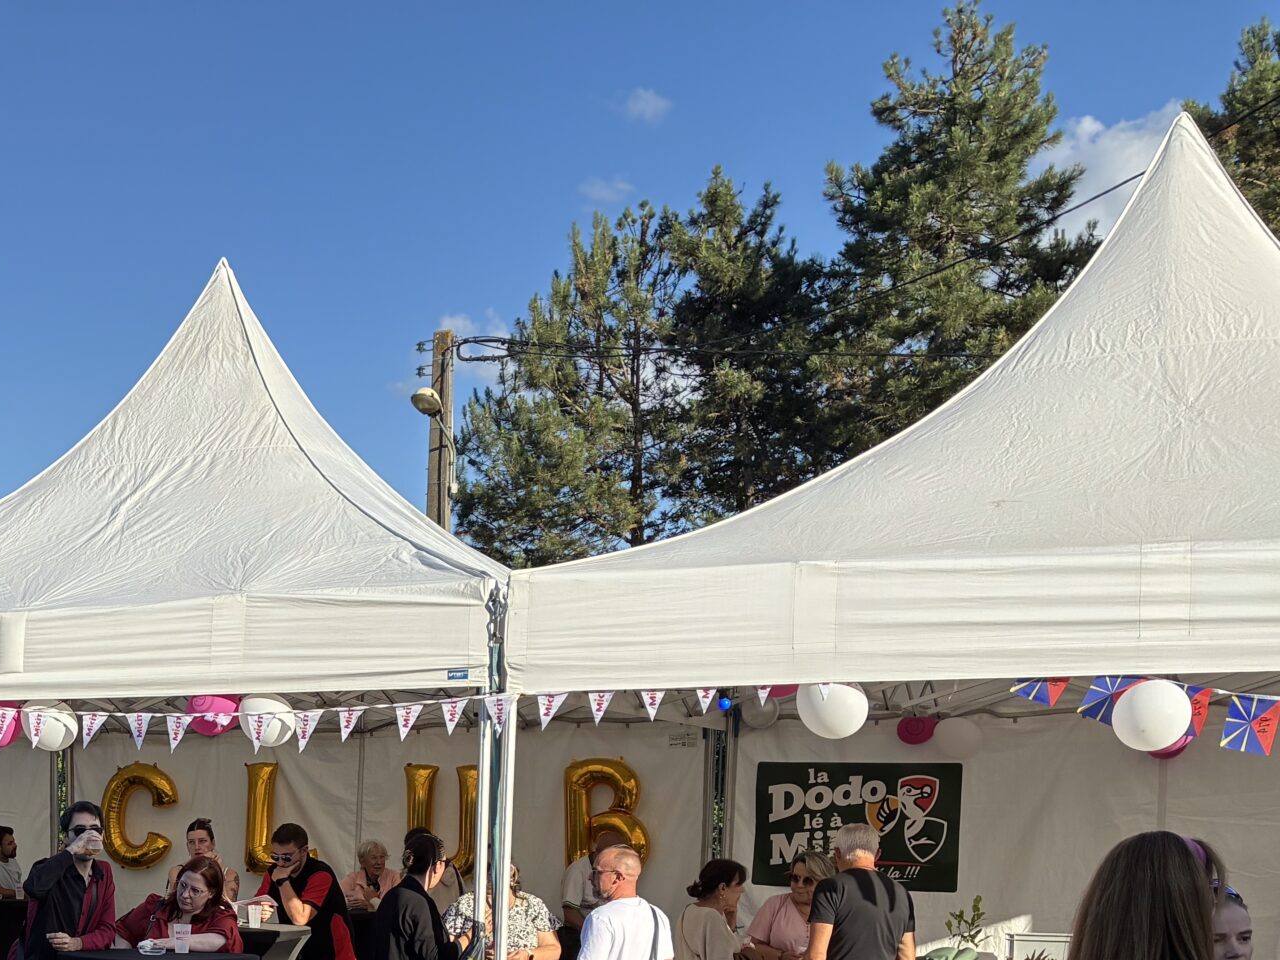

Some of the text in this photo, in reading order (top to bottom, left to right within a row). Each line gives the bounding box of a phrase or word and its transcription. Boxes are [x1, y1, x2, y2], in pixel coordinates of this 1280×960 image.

[808, 768, 829, 783] la
[768, 775, 886, 823] Dodo
[804, 813, 843, 829] lé à
[887, 866, 901, 878] la
